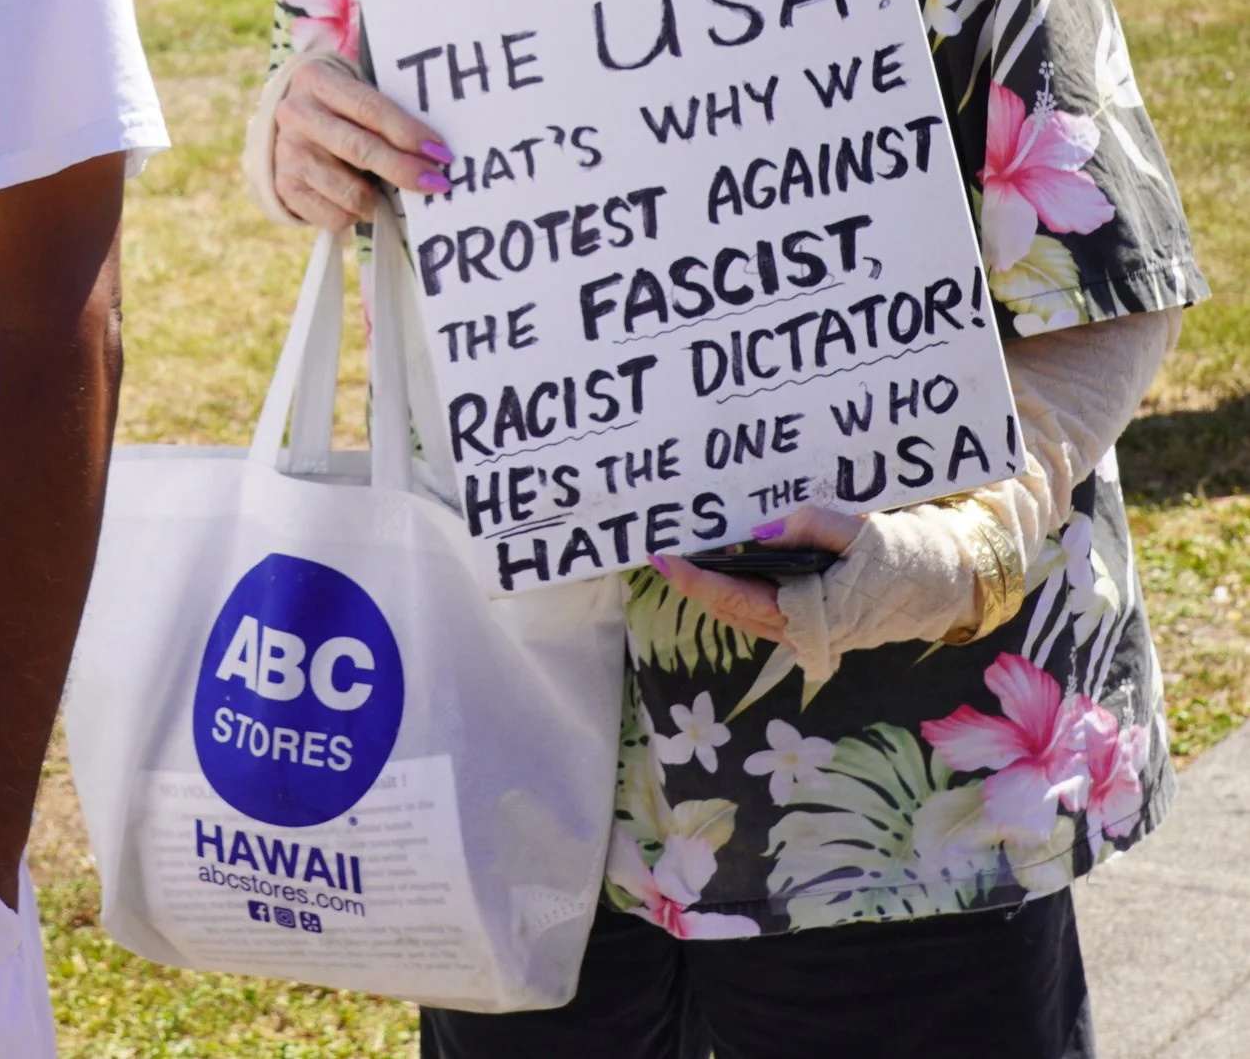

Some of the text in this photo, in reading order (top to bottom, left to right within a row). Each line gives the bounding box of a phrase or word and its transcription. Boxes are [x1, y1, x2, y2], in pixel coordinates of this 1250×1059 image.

[397, 30, 545, 114] THE
[424, 43, 908, 207] HAT'S WHY WE
[417, 115, 945, 297] PROTEST AGAINST
[438, 214, 883, 364] THE FASCIST,
[448, 265, 988, 465] RACIST DICTATOR!
[464, 374, 960, 538] HE'S THE ONE WHO
[496, 415, 1018, 591] HATES THE USA!
[214, 614, 376, 712] ABC
[210, 707, 354, 773] STORES
[195, 817, 363, 895] HAWAII
[197, 862, 367, 918] abcstores.com
